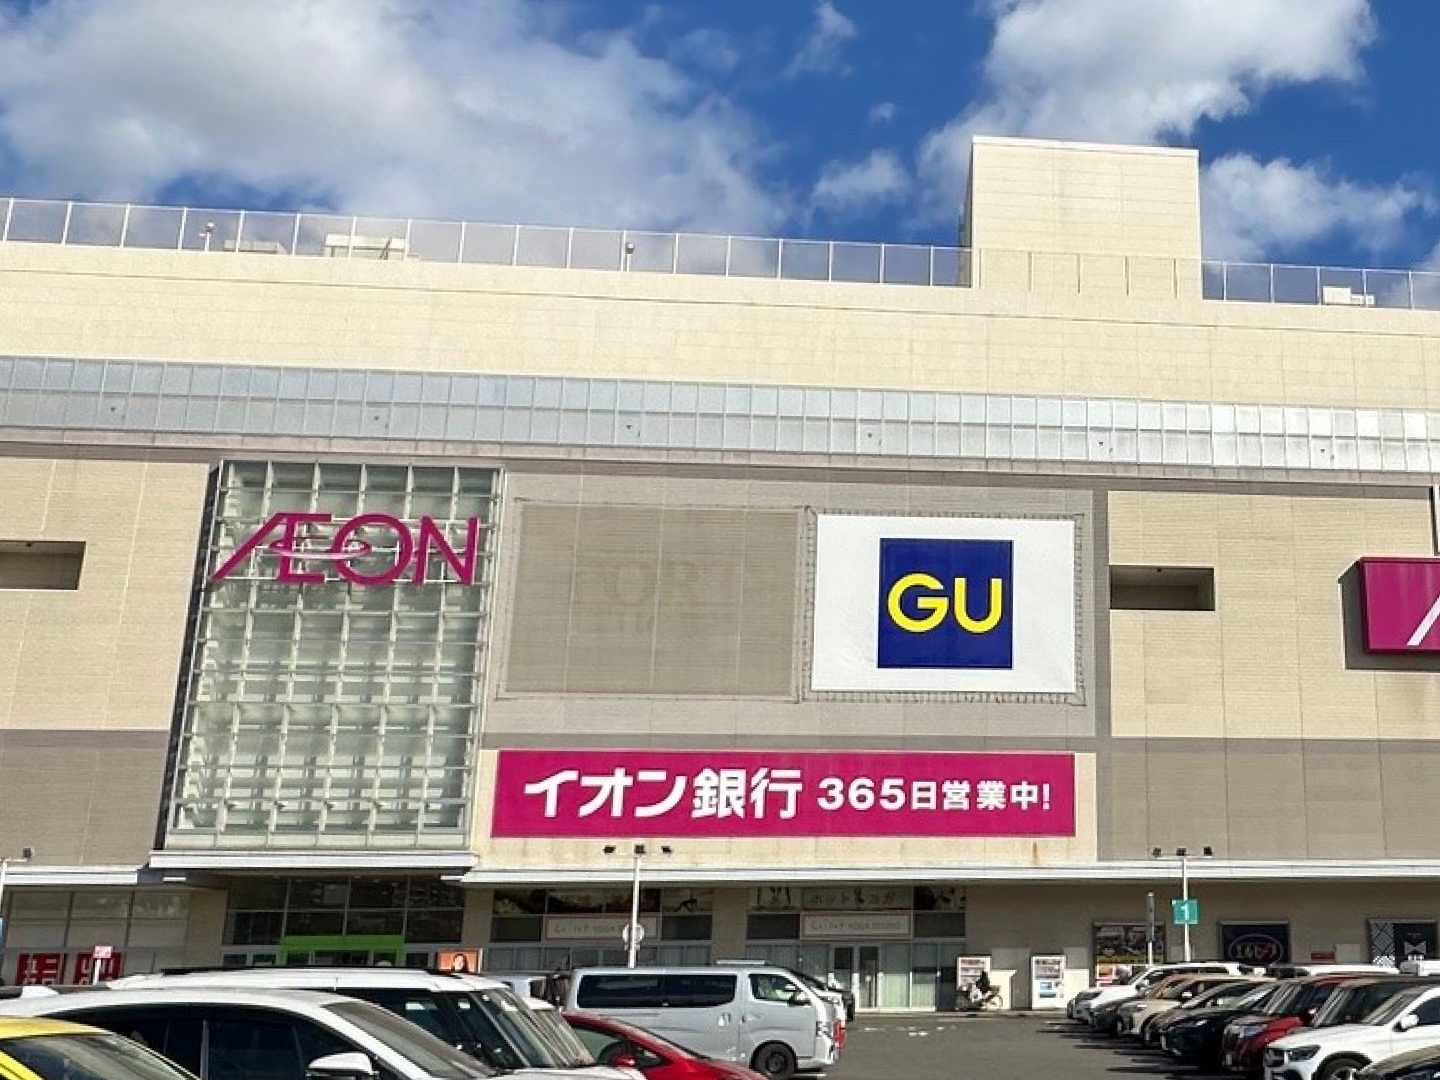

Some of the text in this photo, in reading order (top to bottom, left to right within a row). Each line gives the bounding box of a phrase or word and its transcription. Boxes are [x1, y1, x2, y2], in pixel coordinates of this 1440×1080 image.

[887, 573, 1003, 633] GU
[524, 767, 1051, 819] イオン銀行 365日営業中!
[1181, 903, 1190, 921] 1
